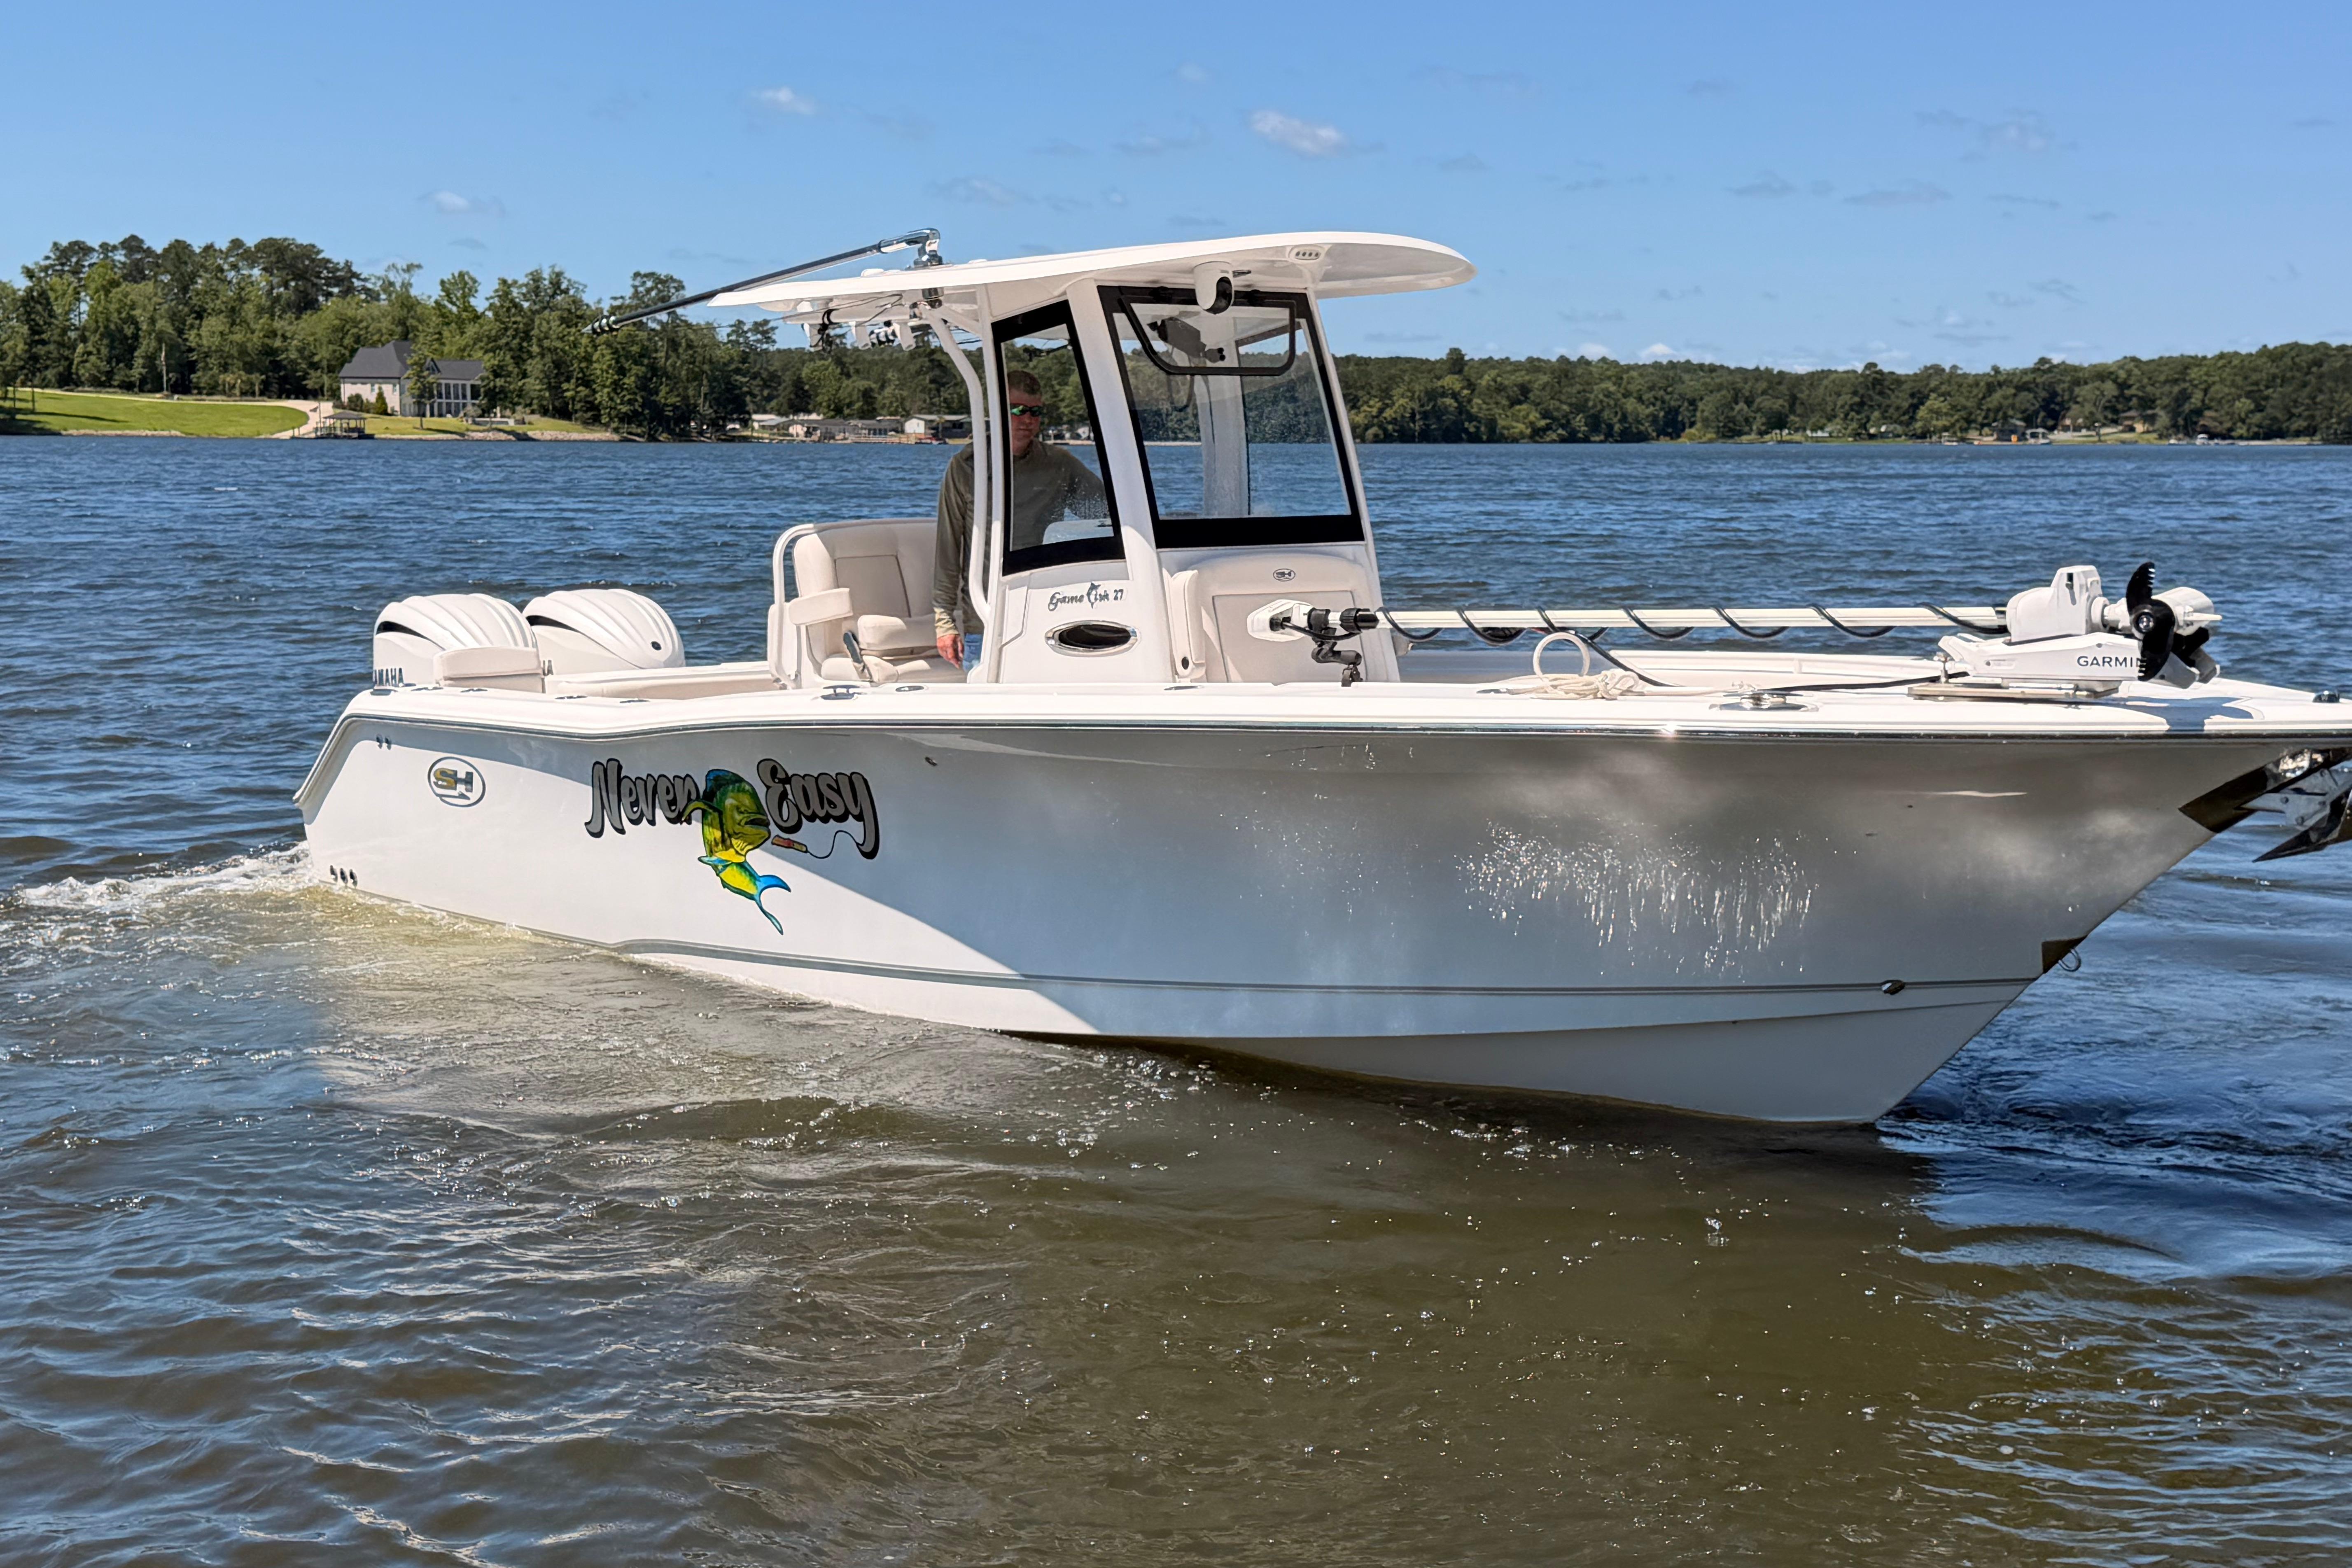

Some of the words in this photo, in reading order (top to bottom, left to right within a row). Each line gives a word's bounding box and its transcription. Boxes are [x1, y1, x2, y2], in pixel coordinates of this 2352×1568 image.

[1113, 589, 1124, 601] 27
[584, 758, 700, 838] Never
[757, 758, 880, 859] Easy
